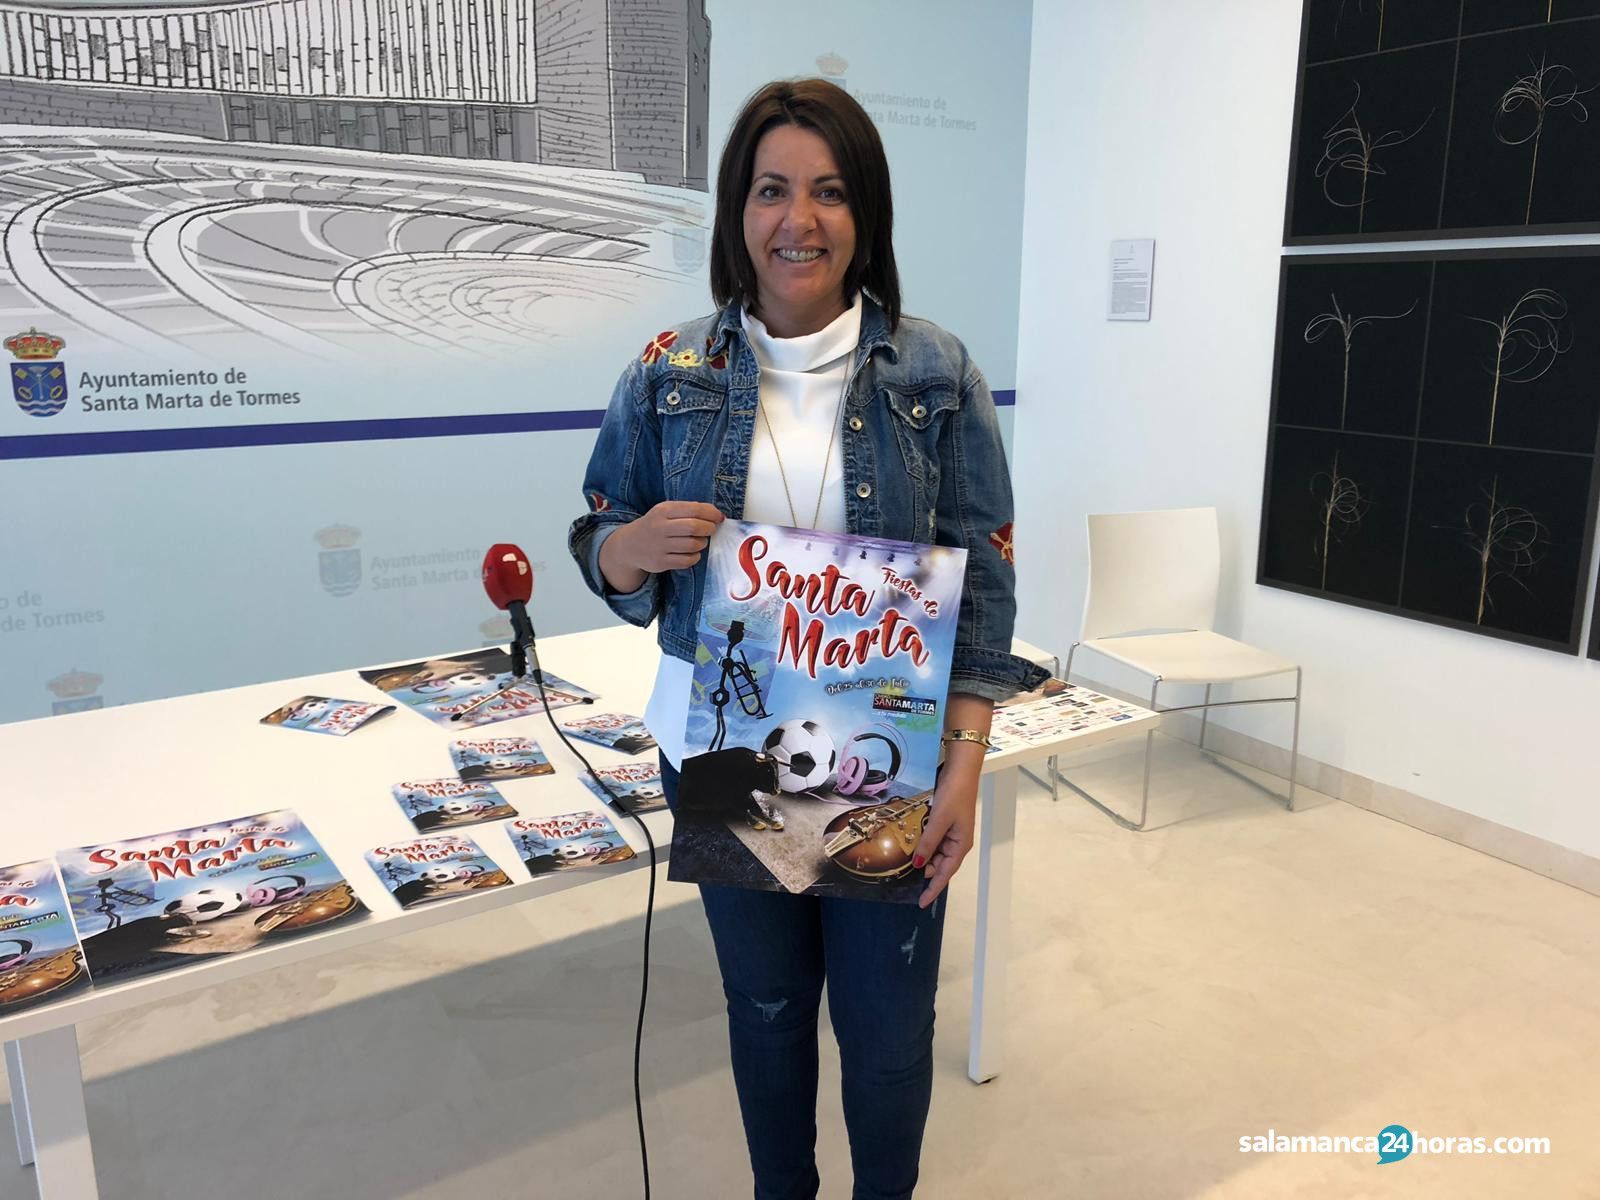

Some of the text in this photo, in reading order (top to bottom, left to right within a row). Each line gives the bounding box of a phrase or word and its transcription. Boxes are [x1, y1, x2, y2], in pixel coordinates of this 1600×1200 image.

[854, 89, 947, 110] Ayuntamiento de
[887, 111, 921, 127] Marta
[923, 113, 937, 128] de
[940, 115, 976, 131] Tormes
[79, 367, 247, 392] Ayuntamiento de
[81, 389, 301, 412] Santa Marta de Tormes
[370, 548, 481, 573] Ayuntamiento
[371, 574, 418, 591] Santa
[423, 567, 469, 585] Marta
[729, 534, 876, 617] Santa
[880, 566, 923, 601] Fiestas
[16, 589, 42, 608] de
[1, 609, 105, 632] de Tormes
[777, 602, 930, 679] Marta
[874, 698, 936, 712] SANTAMARTA
[88, 837, 226, 875] Santa
[149, 837, 295, 882] Marta
